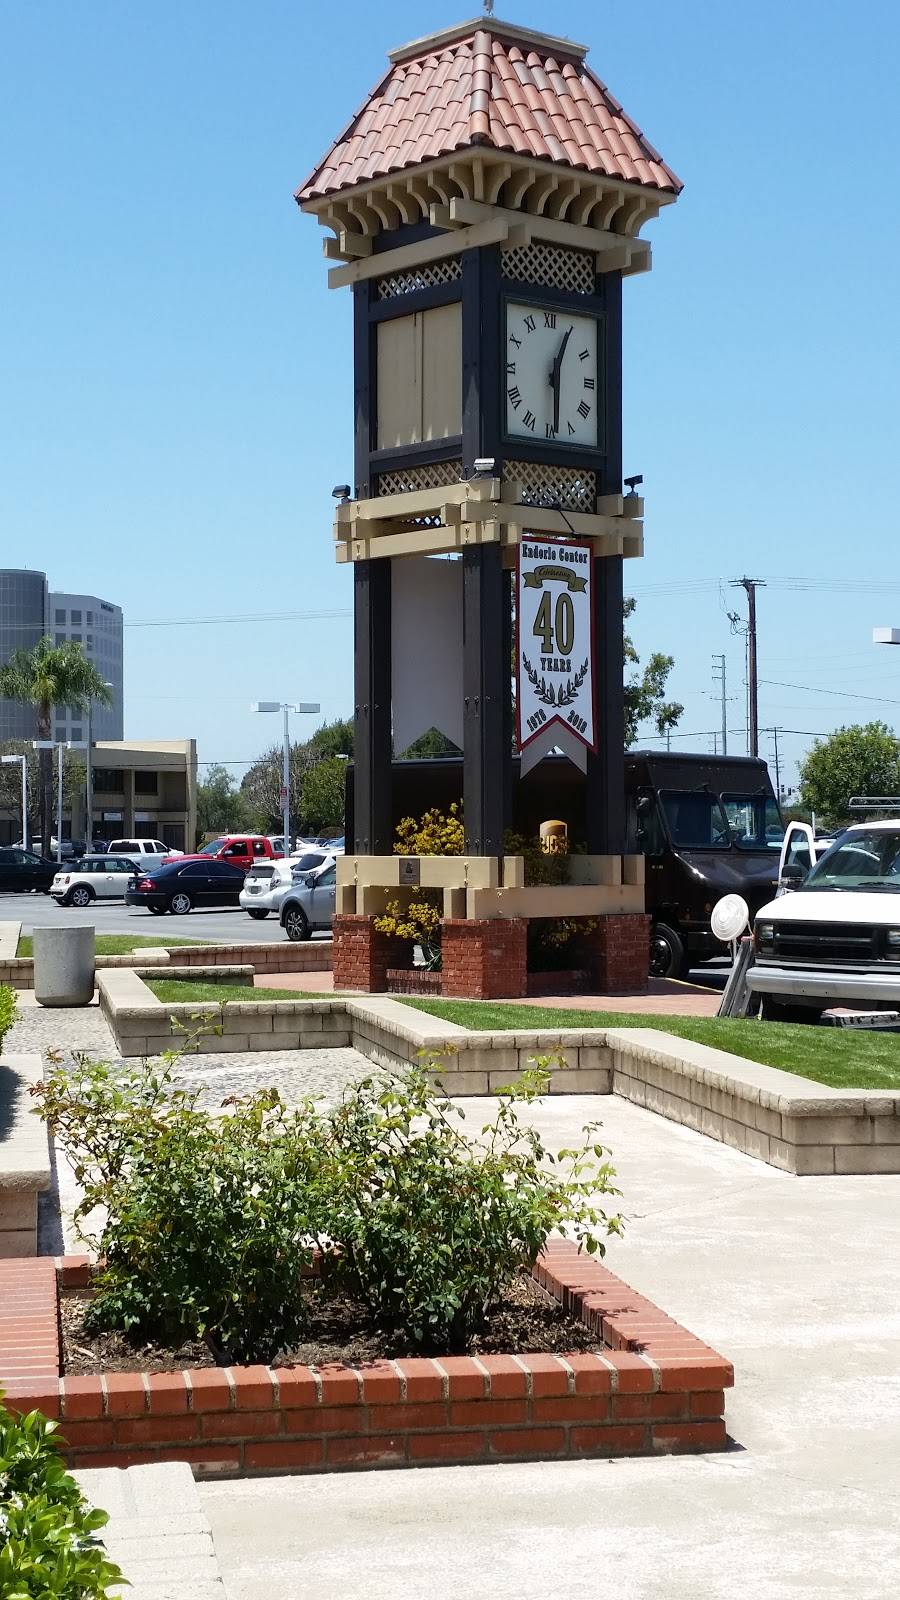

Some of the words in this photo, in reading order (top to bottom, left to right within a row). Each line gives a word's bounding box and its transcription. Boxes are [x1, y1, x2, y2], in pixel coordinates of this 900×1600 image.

[523, 314, 536, 333] XI
[544, 312, 556, 329] XII
[509, 333, 522, 349] X
[579, 348, 589, 362] II
[584, 377, 594, 390] III
[507, 385, 522, 410] VIII
[577, 400, 591, 419] IIII
[522, 409, 536, 432] VII
[567, 421, 575, 435] V
[545, 423, 556, 439] VI
[522, 544, 556, 560] Enderle
[559, 548, 588, 564] Center
[532, 591, 575, 656] 40
[540, 657, 571, 673] YEARS
